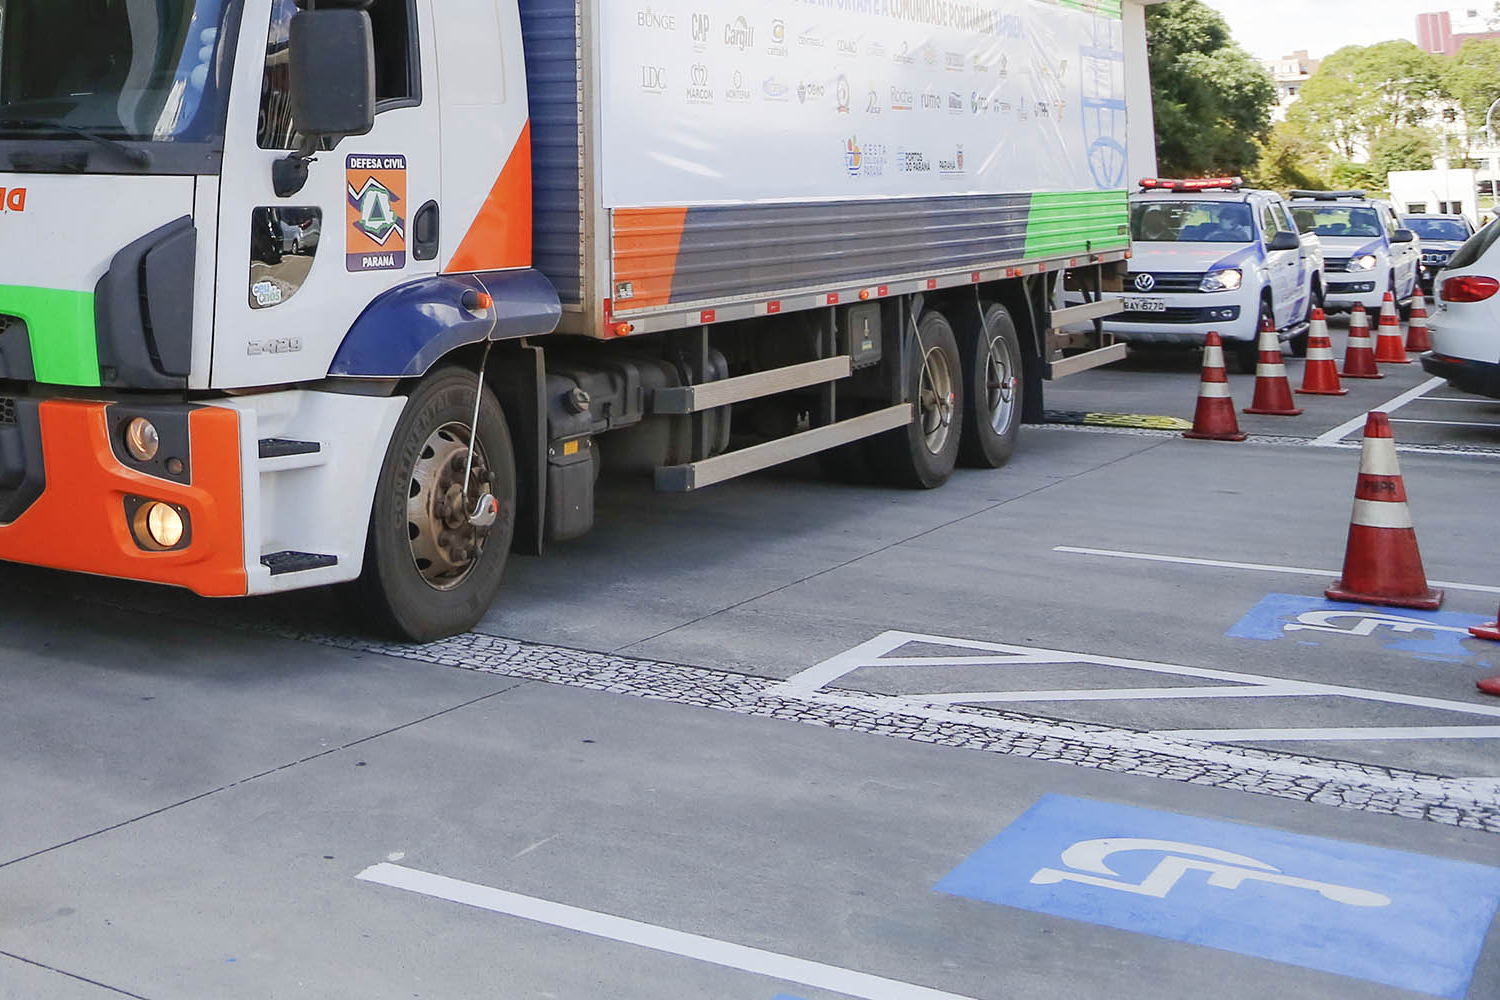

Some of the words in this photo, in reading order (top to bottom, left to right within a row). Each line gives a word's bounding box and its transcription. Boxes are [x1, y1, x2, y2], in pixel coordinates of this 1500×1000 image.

[637, 10, 675, 31] BUNGE
[691, 12, 710, 42] CAP
[724, 22, 754, 51] Cargill
[350, 158, 382, 169] DEFESA
[383, 158, 405, 169] CIVIL
[362, 254, 395, 268] PARANÁ
[247, 337, 302, 356] 2429
